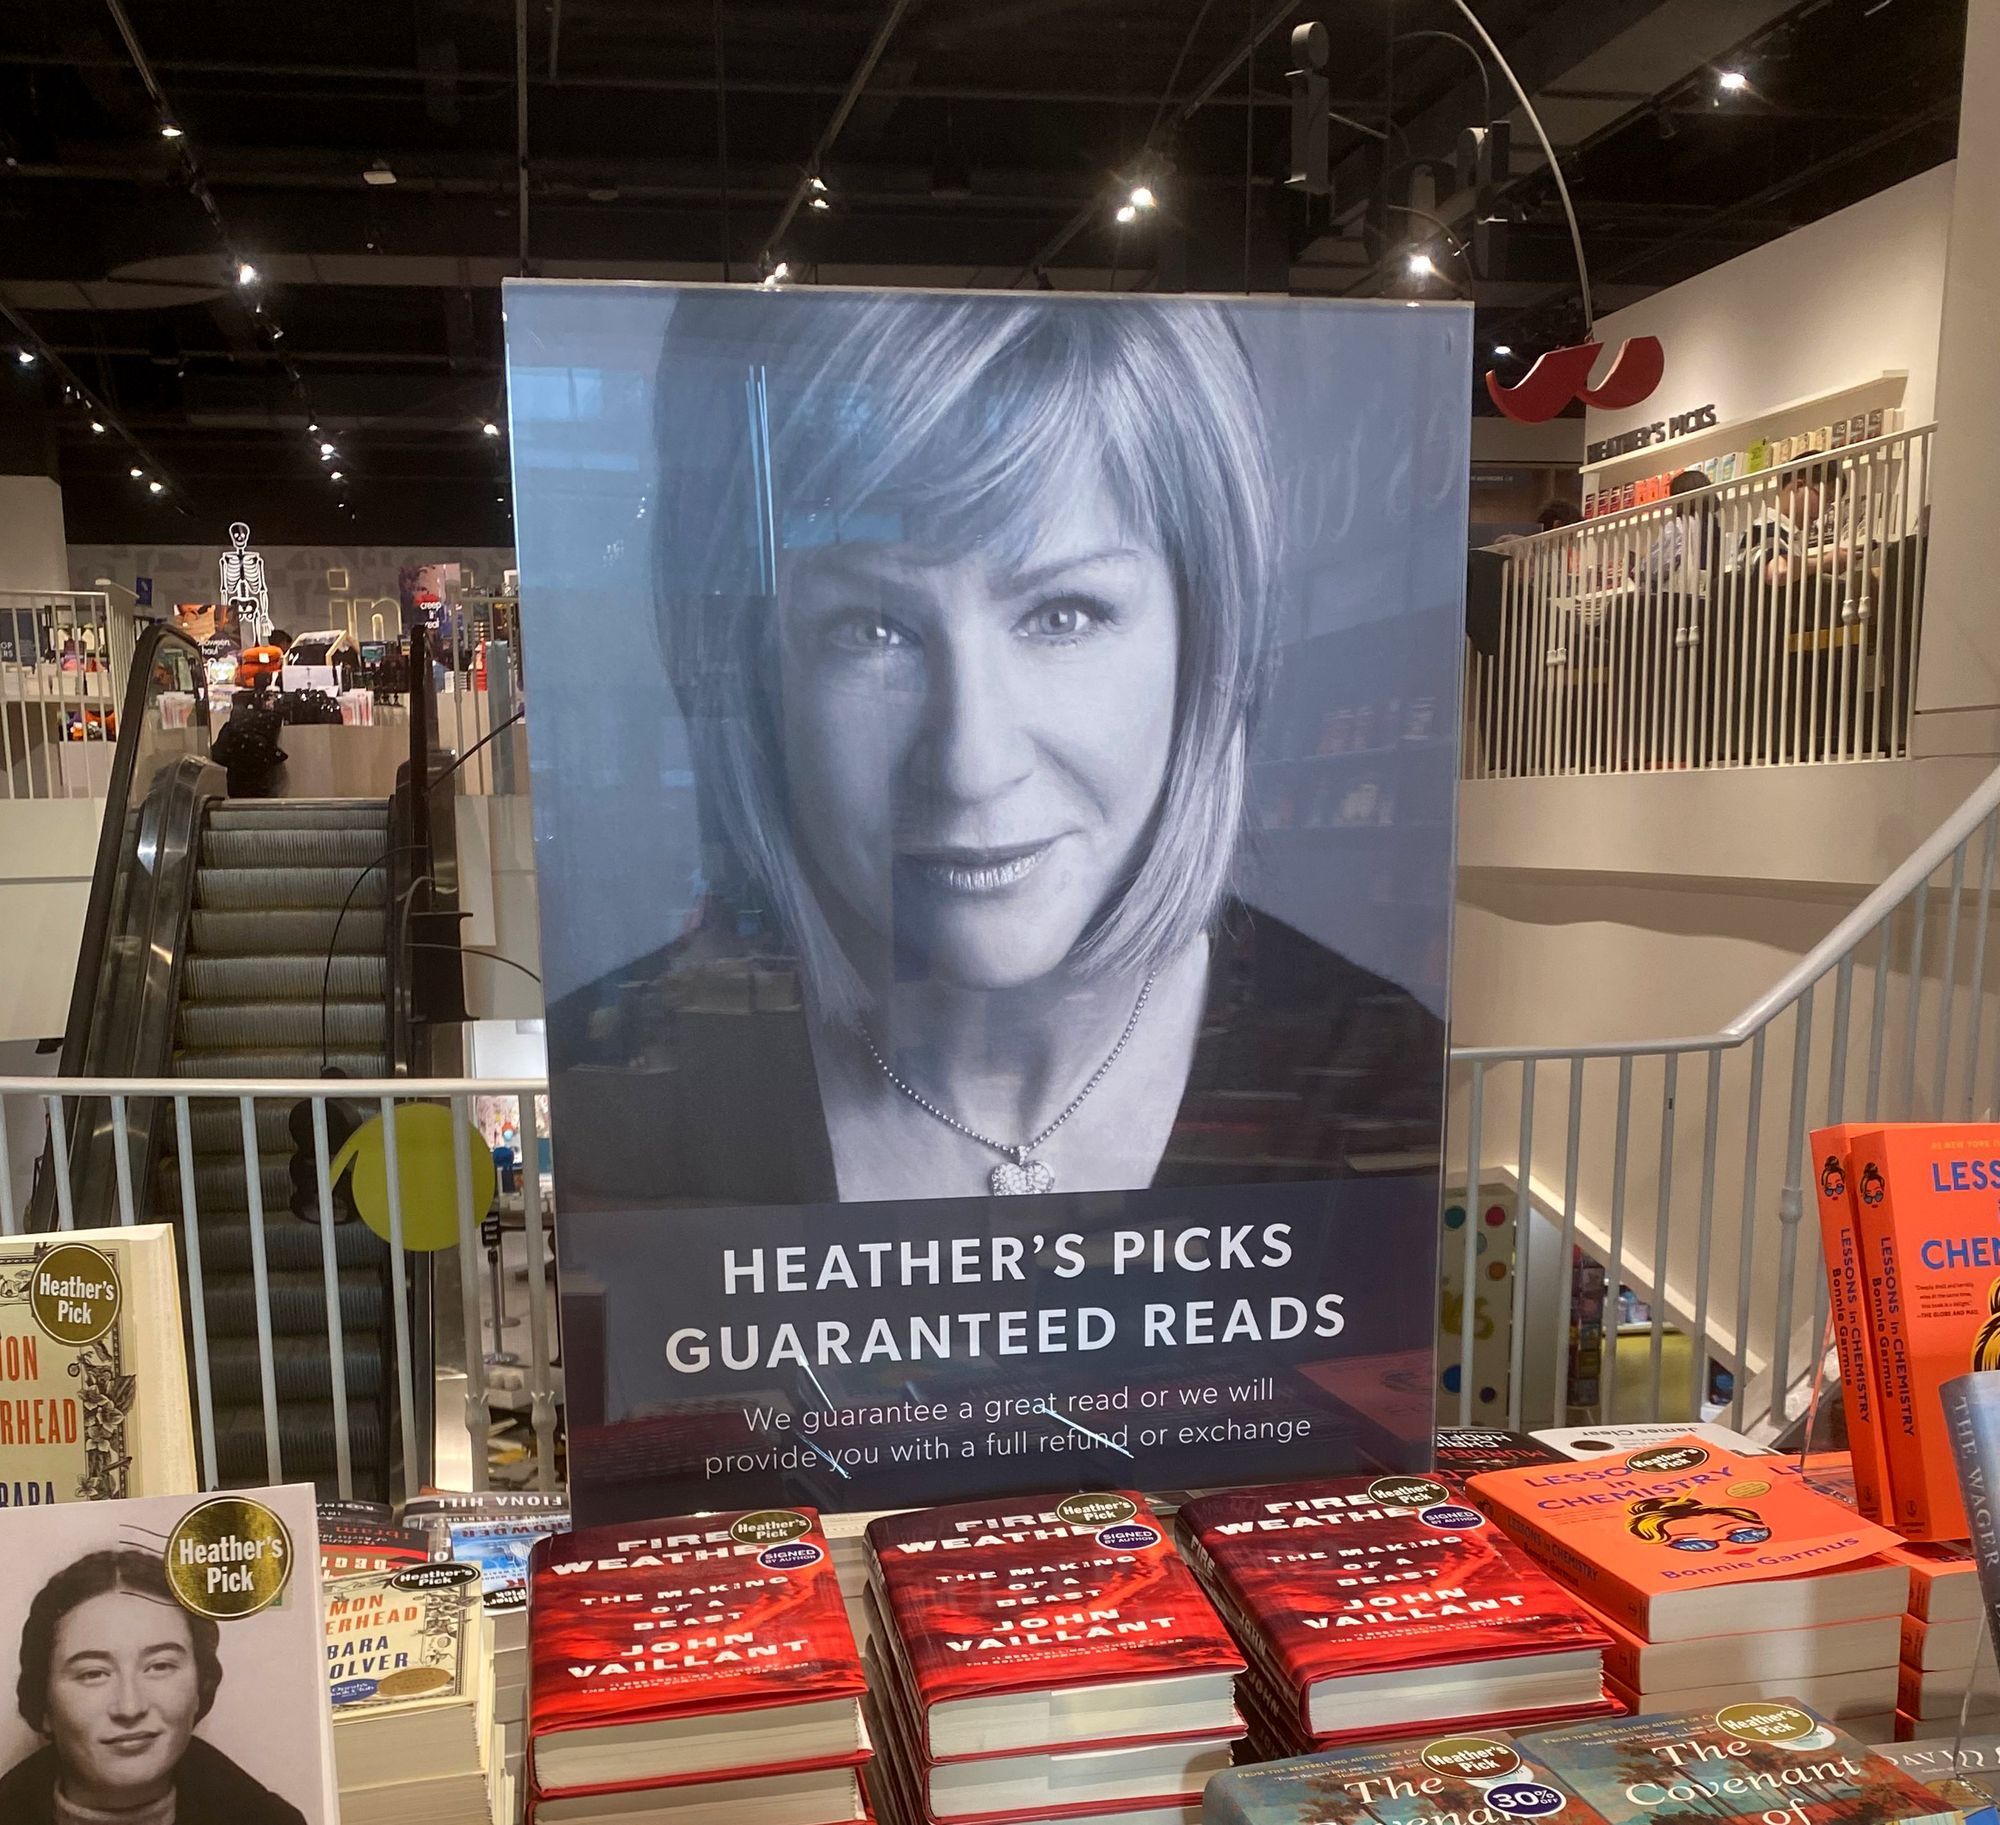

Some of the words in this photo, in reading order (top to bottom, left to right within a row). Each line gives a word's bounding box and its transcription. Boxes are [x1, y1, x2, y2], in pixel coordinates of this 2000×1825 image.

[1669, 404, 1718, 439] PICKS
[724, 1233, 1087, 1295] HEATHER'S
[1113, 1222, 1294, 1276] PICKS
[40, 1272, 116, 1301] Heather's
[1832, 1268, 1845, 1323] Bonnie
[57, 1301, 92, 1325] Pick
[1871, 1277, 1886, 1333] Bonnie
[665, 1306, 1117, 1374] GUARANTEED
[1144, 1293, 1346, 1348] READS
[1840, 1227, 1857, 1305] LESSONS
[1850, 1326, 1870, 1424] CHEMISTRY
[1880, 1236, 1900, 1314] LESSONS
[1892, 1338, 1915, 1438] CHEMISTRY
[0, 1336, 39, 1381] ON
[1838, 1324, 1853, 1387] Garmus
[1878, 1334, 1894, 1399] Garmus
[744, 1407, 792, 1433] We
[803, 1399, 948, 1435] guarantee
[960, 1405, 973, 1420] a
[985, 1393, 1057, 1424] great
[1068, 1383, 1130, 1411] read
[1140, 1391, 1168, 1407] or
[1179, 1388, 1218, 1405] we
[1228, 1377, 1275, 1402] will
[1582, 1428, 1634, 1437] Clear
[1639, 1426, 1698, 1434] James
[705, 1442, 817, 1480] provide
[828, 1446, 880, 1472] you
[891, 1434, 951, 1461] with
[961, 1441, 975, 1457] a
[986, 1429, 1028, 1456] full
[1039, 1423, 1129, 1452] refund
[1139, 1429, 1168, 1446] or
[1178, 1417, 1312, 1452] exchange
[1658, 1458, 1690, 1470] Pick
[1523, 1465, 1634, 1488] LESSO
[1536, 1465, 1734, 1511] CHEMISTRY
[1607, 1478, 1635, 1489] in
[1955, 1396, 1978, 1459] THE
[1968, 1467, 2000, 1567] WAGER
[438, 1496, 484, 1509] HILL
[495, 1496, 563, 1507] FIONA
[1373, 1483, 1440, 1499] Heather's
[1398, 1493, 1433, 1504] Pick
[1063, 1502, 1131, 1515] Heather's
[1083, 1511, 1116, 1521] Pick
[1263, 1493, 1375, 1515] FIRE
[1426, 1511, 1474, 1521] SIGNED
[738, 1519, 807, 1533] Heather's
[954, 1512, 1059, 1533] FIRE
[1215, 1503, 1446, 1536] WEATHE
[618, 1530, 732, 1552] FIRE
[756, 1529, 788, 1540] Pick
[897, 1520, 1135, 1554] WEATHE
[1102, 1531, 1153, 1540] SIGNED
[180, 1535, 284, 1566] Heather's
[551, 1539, 800, 1575] WEATHE
[765, 1549, 816, 1560] SIGNED
[780, 1555, 816, 1563] AUTHOR
[1190, 1534, 1216, 1577] FIRE
[1267, 1552, 1328, 1563] THE
[1338, 1536, 1463, 1557] MAKING
[1660, 1559, 1752, 1581] Bonnie
[1758, 1534, 1860, 1567] Garmus
[936, 1570, 997, 1584] THE
[1008, 1555, 1137, 1577] MAKING
[1343, 1560, 1381, 1571] OF
[1397, 1556, 1415, 1566] A
[207, 1565, 255, 1594] Pick
[400, 1569, 473, 1583] Heather's
[419, 1577, 452, 1586] Pick
[1008, 1580, 1048, 1591] OF
[1062, 1576, 1081, 1586] A
[1337, 1569, 1440, 1587] BEAST
[580, 1593, 643, 1606] THE
[657, 1576, 789, 1600] MAKING
[996, 1588, 1103, 1608] BEAST
[1343, 1587, 1467, 1611] JOHN
[651, 1602, 692, 1614] OF
[708, 1599, 725, 1608] A
[1302, 1595, 1526, 1630] VAILLANT
[633, 1611, 745, 1631] BEAST
[992, 1608, 1121, 1632] JOHN
[620, 1631, 754, 1657] JOHN
[946, 1617, 1176, 1653] VAILLANT
[330, 1652, 409, 1679] OLVER
[568, 1639, 809, 1679] VAILLANT
[1724, 1708, 1801, 1732] Heather's
[1755, 1721, 1797, 1738] Pick
[1428, 1745, 1509, 1769] Heather's
[1651, 1740, 1752, 1768] The
[1462, 1760, 1501, 1774] Pick
[1344, 1774, 1446, 1805] The
[1625, 1755, 1862, 1807] Covenant
[1540, 1797, 1560, 1805] OFF
[1762, 1798, 1806, 1825] of
